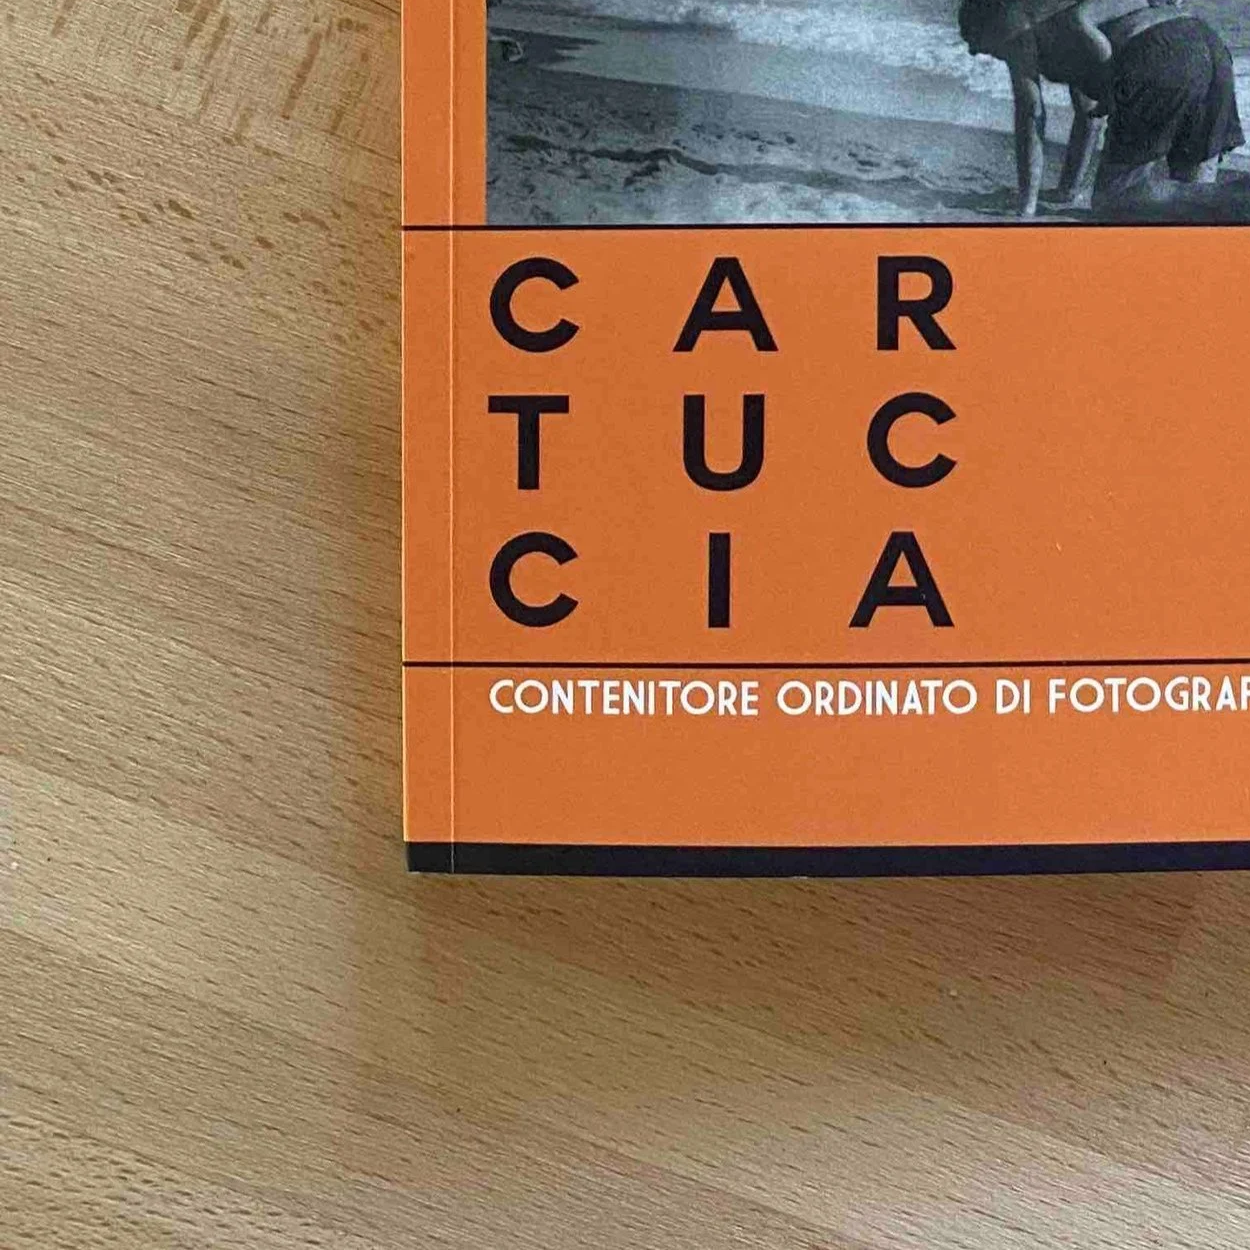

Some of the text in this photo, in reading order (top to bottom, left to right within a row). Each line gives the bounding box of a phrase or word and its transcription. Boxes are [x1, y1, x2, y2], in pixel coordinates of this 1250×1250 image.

[489, 679, 759, 716] CONTENITORE
[776, 679, 978, 716] ORDINATO
[995, 679, 1031, 715] DI
